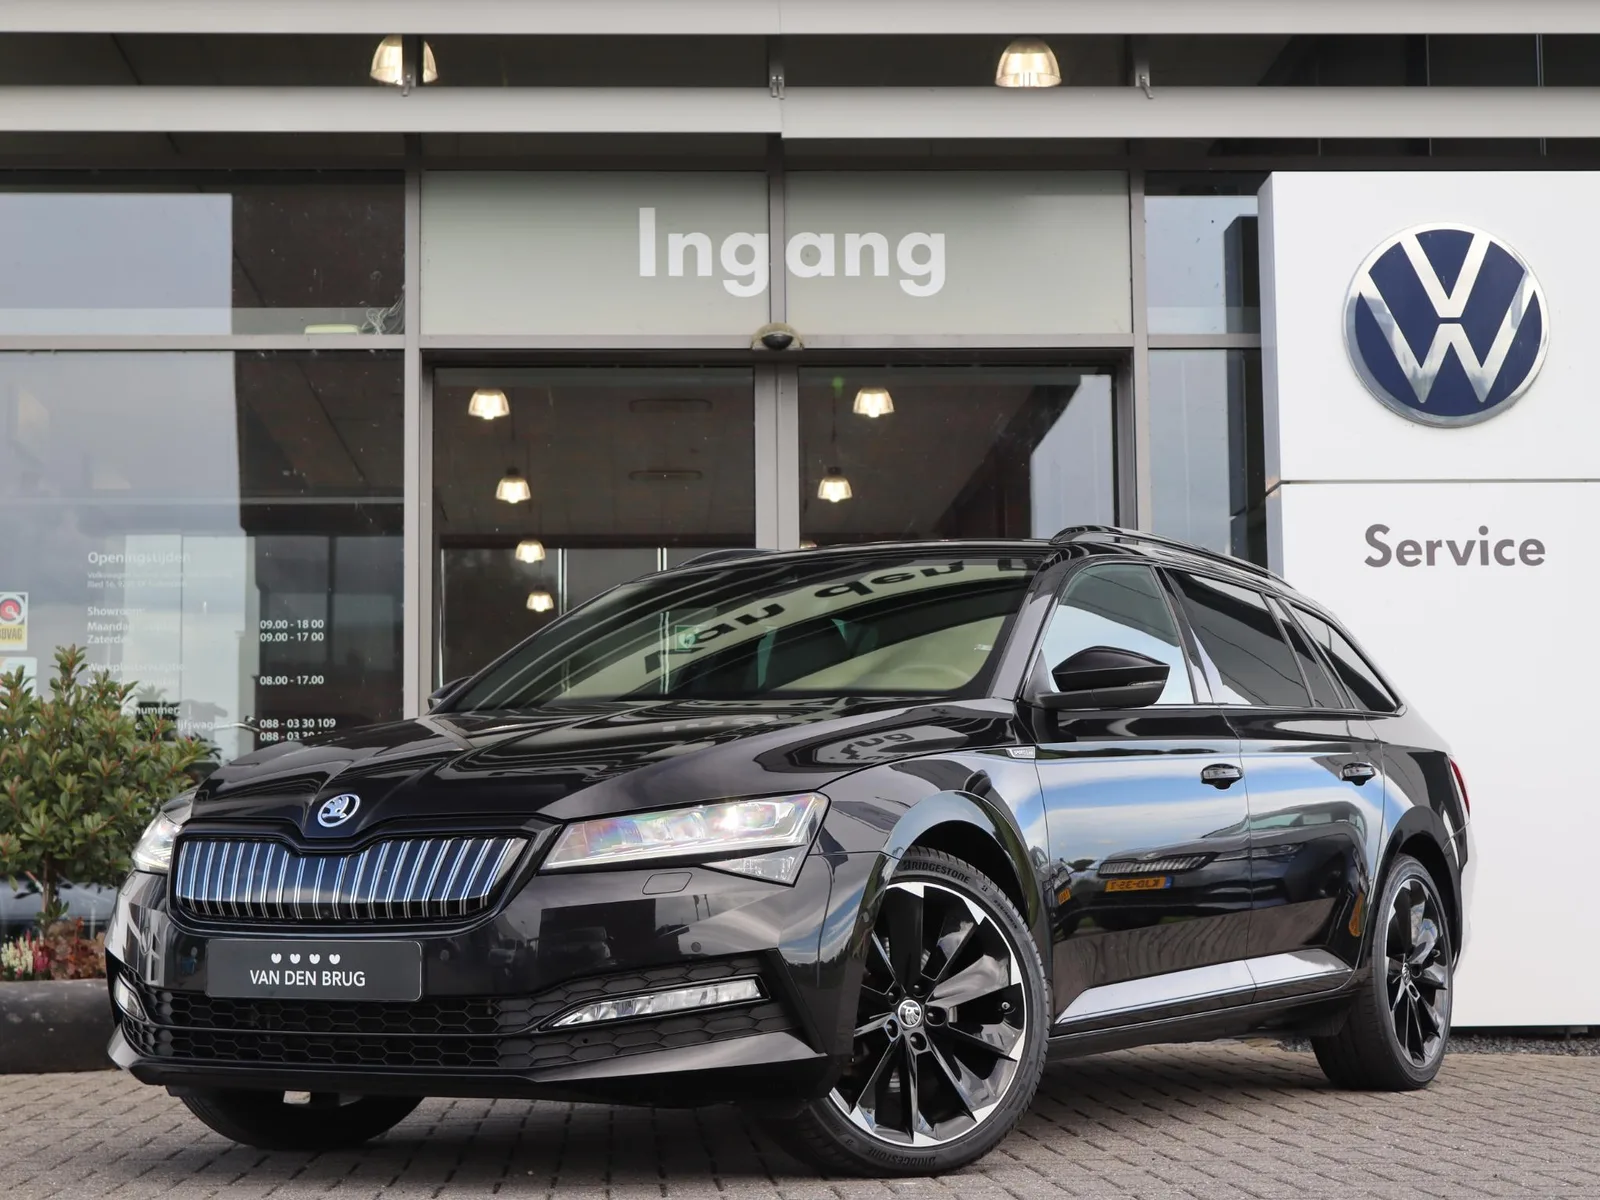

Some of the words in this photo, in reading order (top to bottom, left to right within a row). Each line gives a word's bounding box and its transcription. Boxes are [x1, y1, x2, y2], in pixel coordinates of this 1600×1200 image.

[639, 207, 946, 297] Ingang
[1364, 523, 1546, 568] Service
[87, 551, 191, 566] Openingstijden
[260, 620, 288, 629] 09.00
[0, 628, 23, 640] OVAG
[260, 632, 288, 642] 09.00
[260, 676, 288, 685] 08.00
[297, 675, 324, 685] 17.00
[133, 706, 181, 715] nummer:
[260, 719, 279, 729] 088
[287, 719, 300, 728] 03
[302, 719, 315, 728] 30
[318, 718, 336, 728] 109
[260, 731, 279, 741] 088
[287, 731, 300, 741] 03
[902, 858, 972, 884] BRIDGESTONE
[250, 969, 280, 985] VAN
[284, 970, 317, 986] DEN
[322, 971, 366, 987] BRUG
